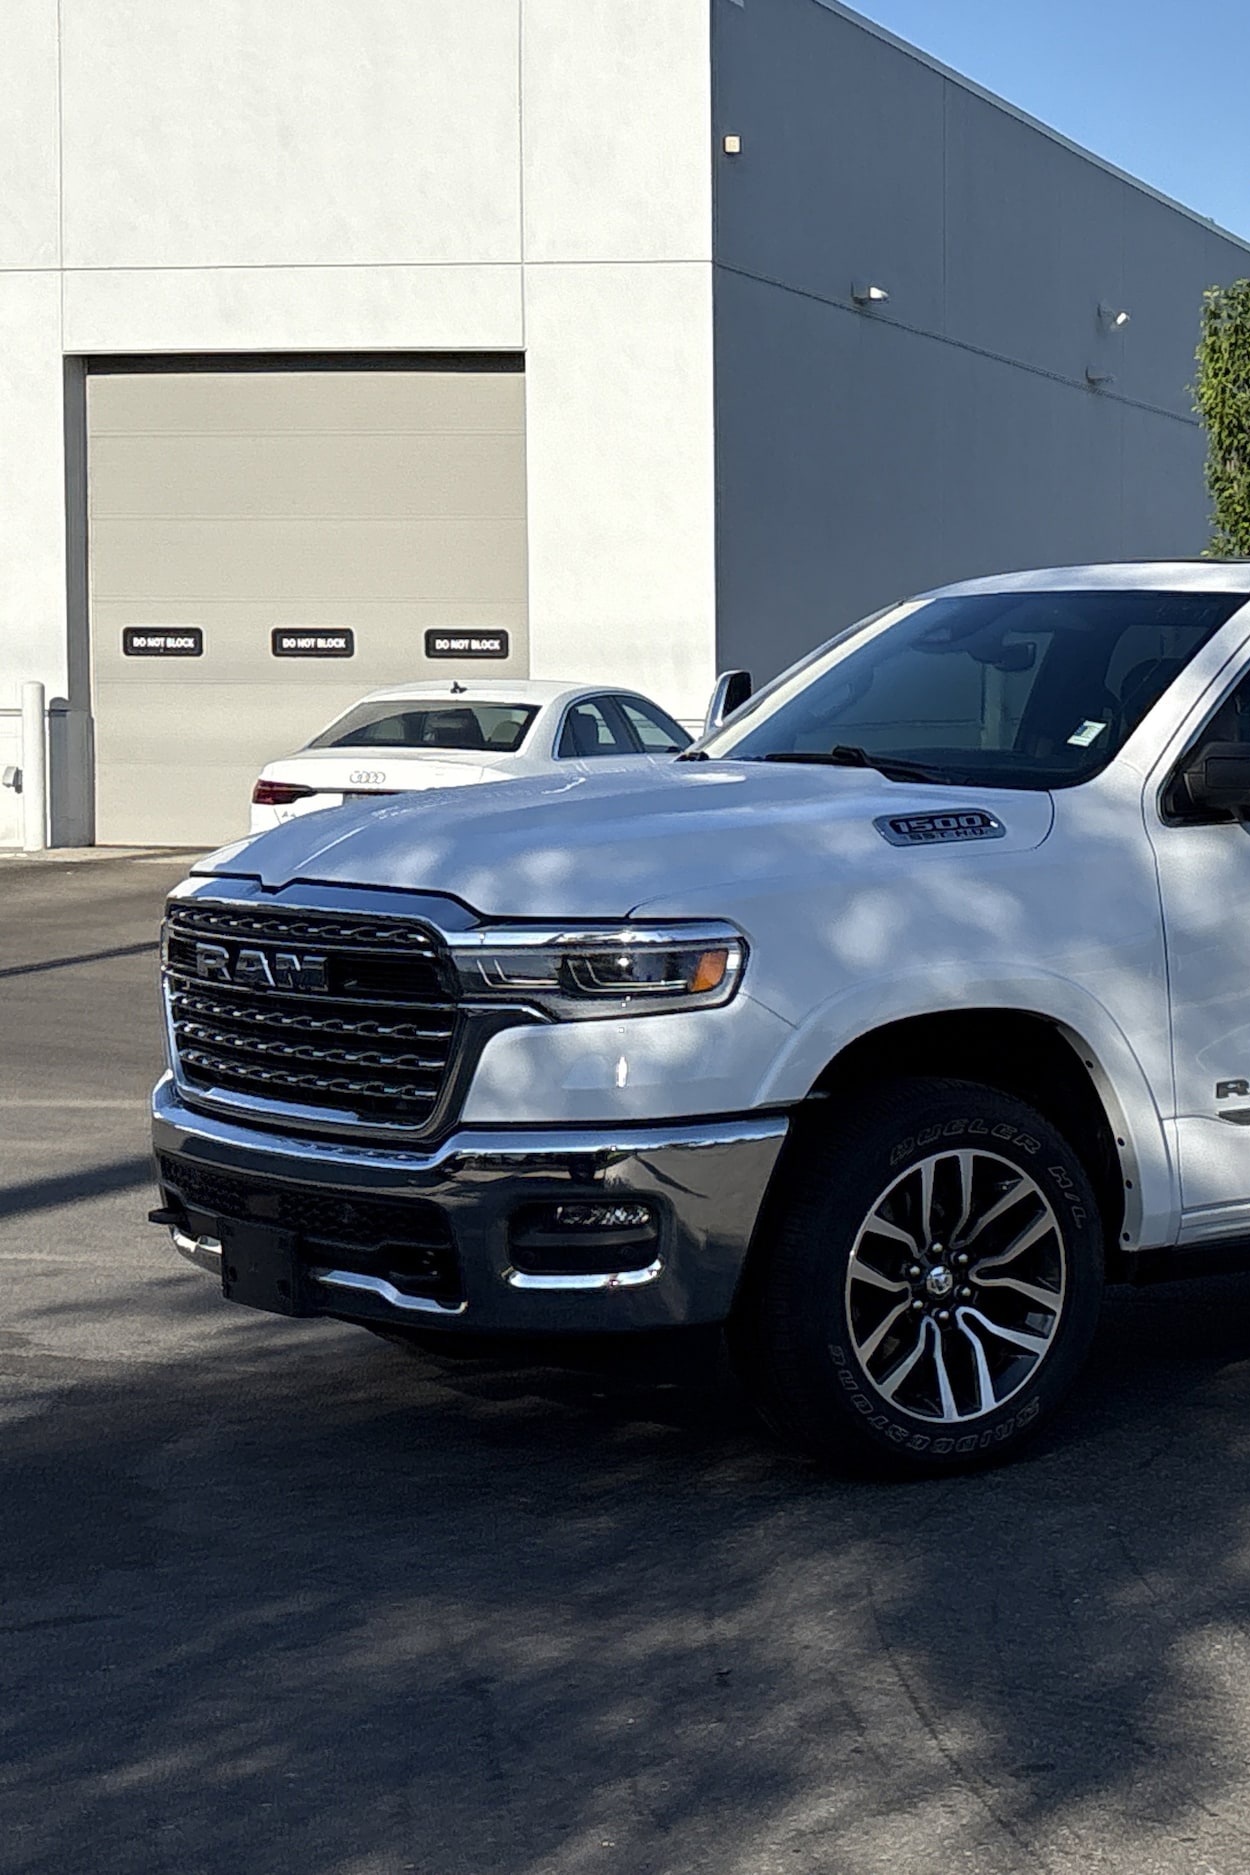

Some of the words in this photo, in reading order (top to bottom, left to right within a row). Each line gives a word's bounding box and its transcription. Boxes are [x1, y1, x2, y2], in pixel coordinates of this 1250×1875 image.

[132, 637, 147, 648] DO
[147, 637, 165, 648] NOT
[166, 637, 195, 649] BLOCK
[282, 638, 297, 649] DO
[297, 638, 316, 649] NOT
[316, 638, 346, 649] BLOCK
[435, 639, 449, 650] DO
[450, 639, 470, 650] NOT
[470, 639, 501, 650] BLOCK
[895, 814, 983, 833] 1500
[195, 942, 329, 992] RAM
[888, 1117, 1043, 1167] DUELER
